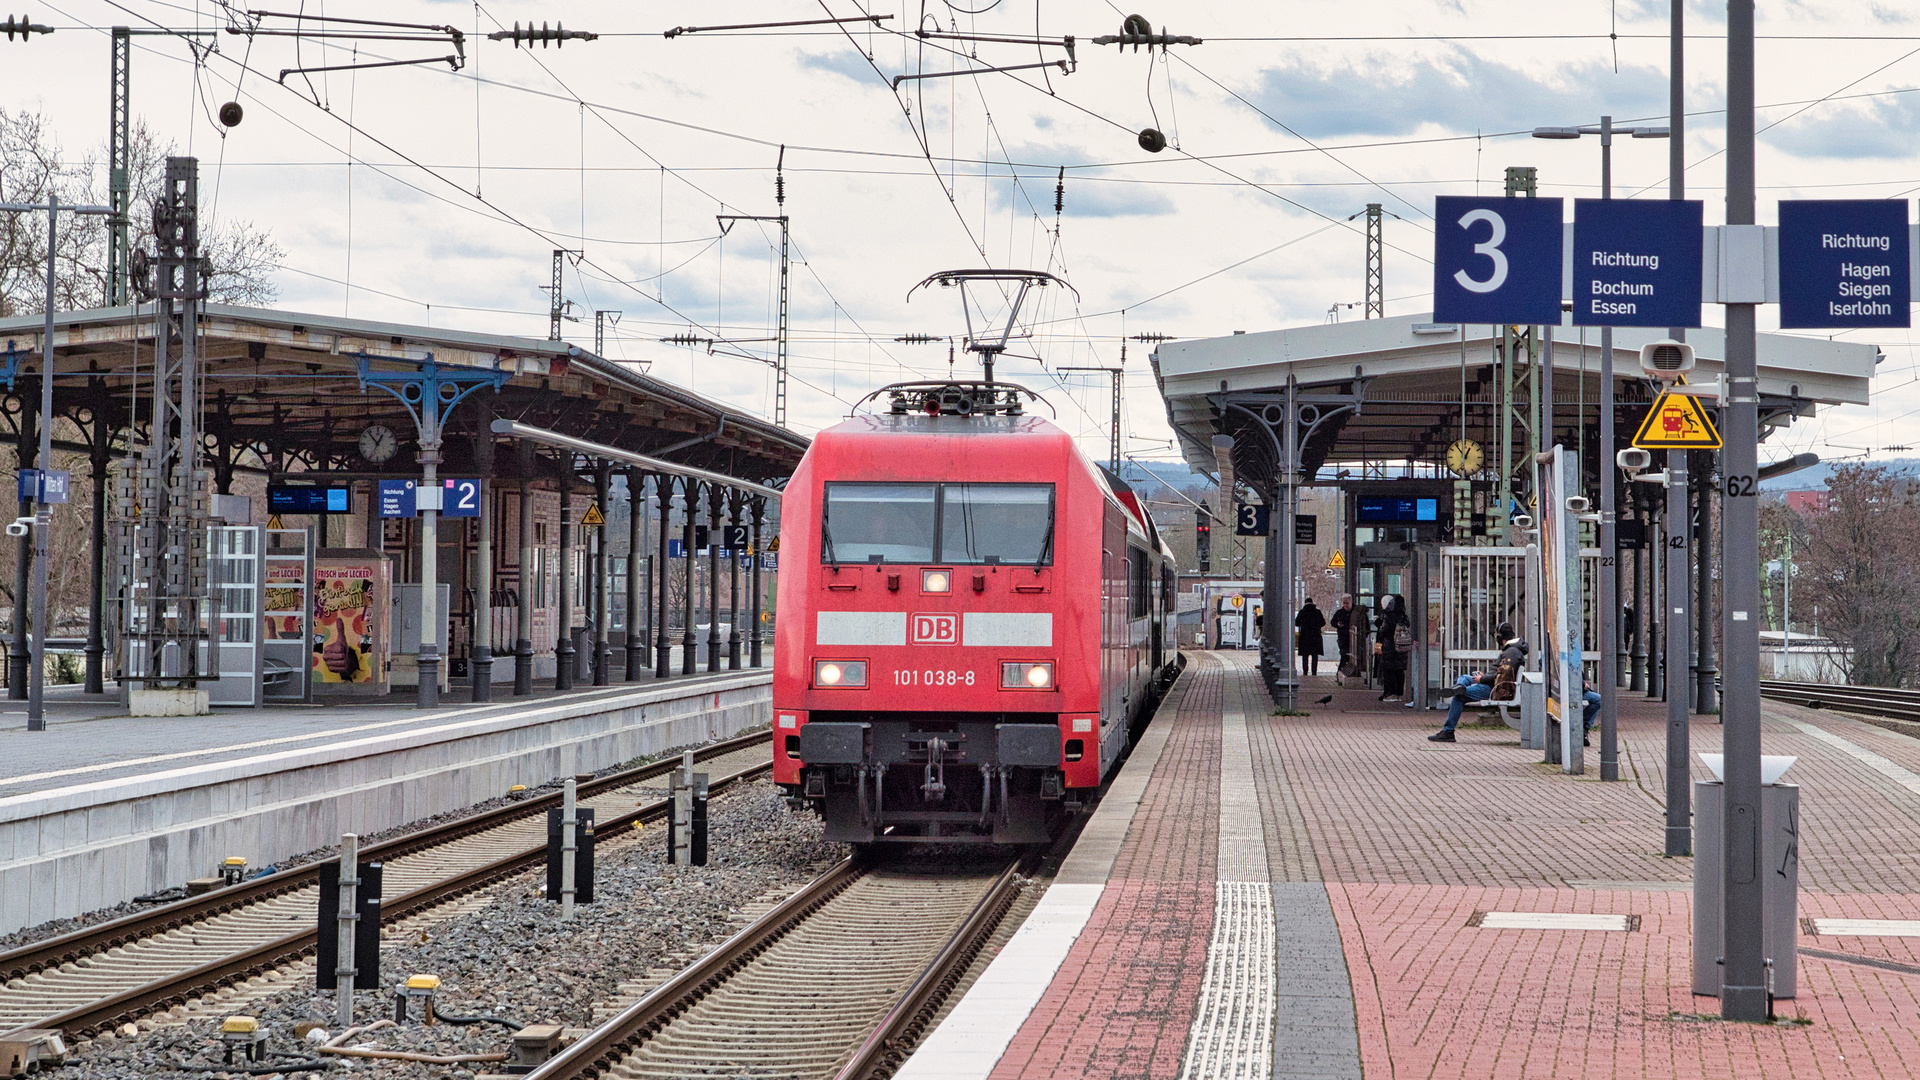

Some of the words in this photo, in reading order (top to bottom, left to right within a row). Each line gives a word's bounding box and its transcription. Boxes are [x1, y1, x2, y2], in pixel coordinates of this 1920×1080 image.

[1453, 208, 1509, 293] 3
[1822, 233, 1890, 252] Richtung
[1592, 251, 1659, 270] Richtung
[1841, 263, 1891, 279] Hagen
[1591, 280, 1654, 296] Bochum
[1838, 281, 1891, 299] Siegen
[1591, 300, 1636, 315] Essen
[1829, 301, 1892, 316] Iserlohn
[458, 482, 475, 509] 2
[1241, 505, 1257, 529] 3
[734, 527, 745, 545] 2
[1602, 556, 1614, 567] 22
[917, 617, 953, 640] DB
[893, 669, 918, 686] 101
[924, 670, 975, 686] 038-8
